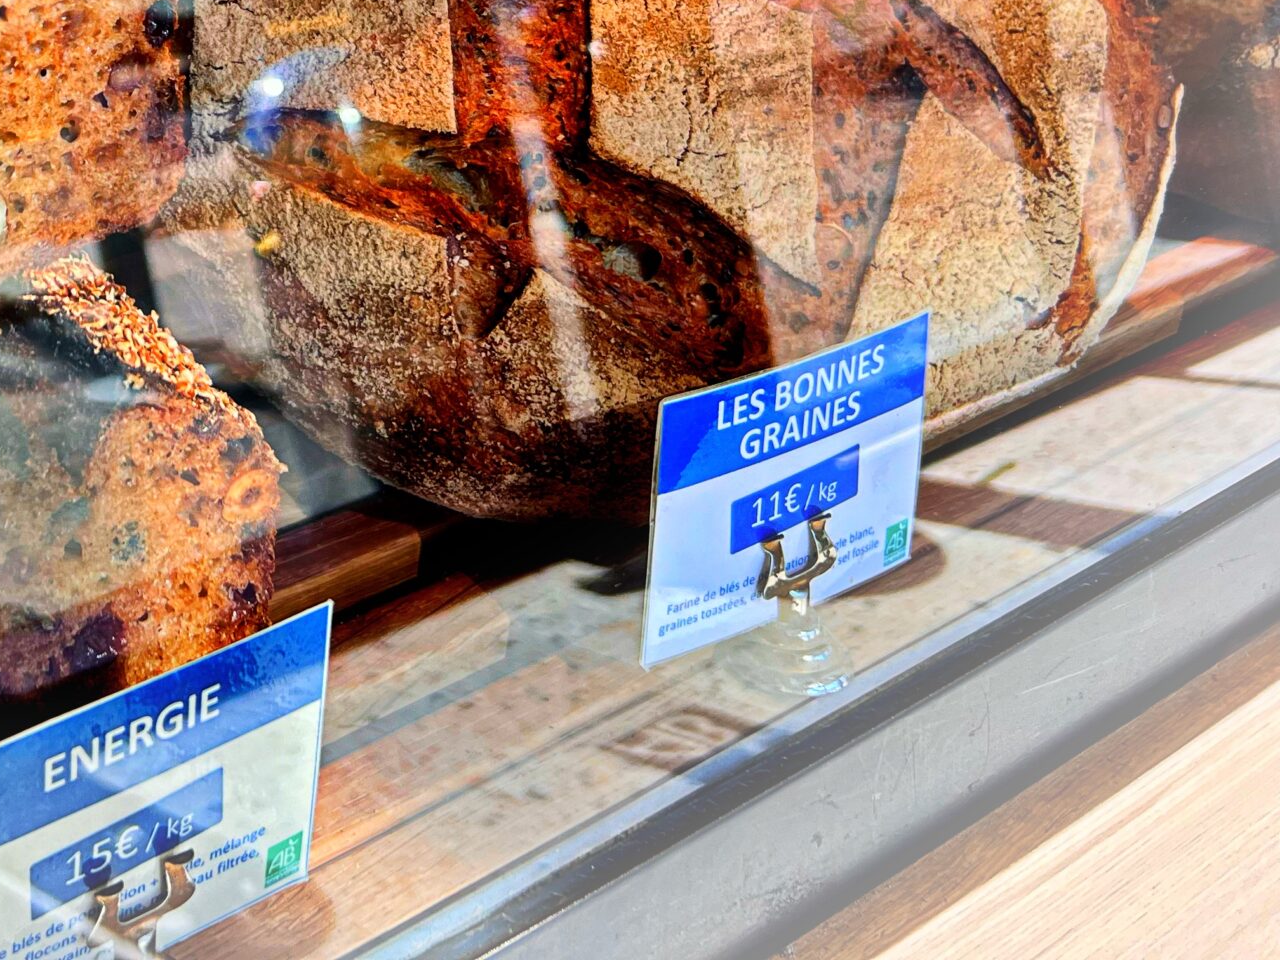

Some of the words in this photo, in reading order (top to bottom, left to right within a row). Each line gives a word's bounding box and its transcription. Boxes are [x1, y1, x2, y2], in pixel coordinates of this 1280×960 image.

[717, 388, 766, 431] LES
[774, 344, 885, 412] BONNES
[739, 391, 861, 460] GRAINES
[658, 613, 698, 638] graines
[701, 595, 748, 621] toastées,
[837, 550, 851, 566] sel
[852, 539, 880, 559] fossile
[666, 594, 700, 616] Farine
[703, 588, 717, 602] de
[719, 579, 741, 598] blés
[743, 575, 756, 588] de
[43, 683, 221, 794] ENERGIE
[11, 930, 42, 954] blés
[45, 921, 65, 938] de
[209, 826, 267, 860] mélange
[24, 933, 78, 960] flocons
[217, 847, 260, 875] filtrée,
[268, 844, 298, 874] AB
